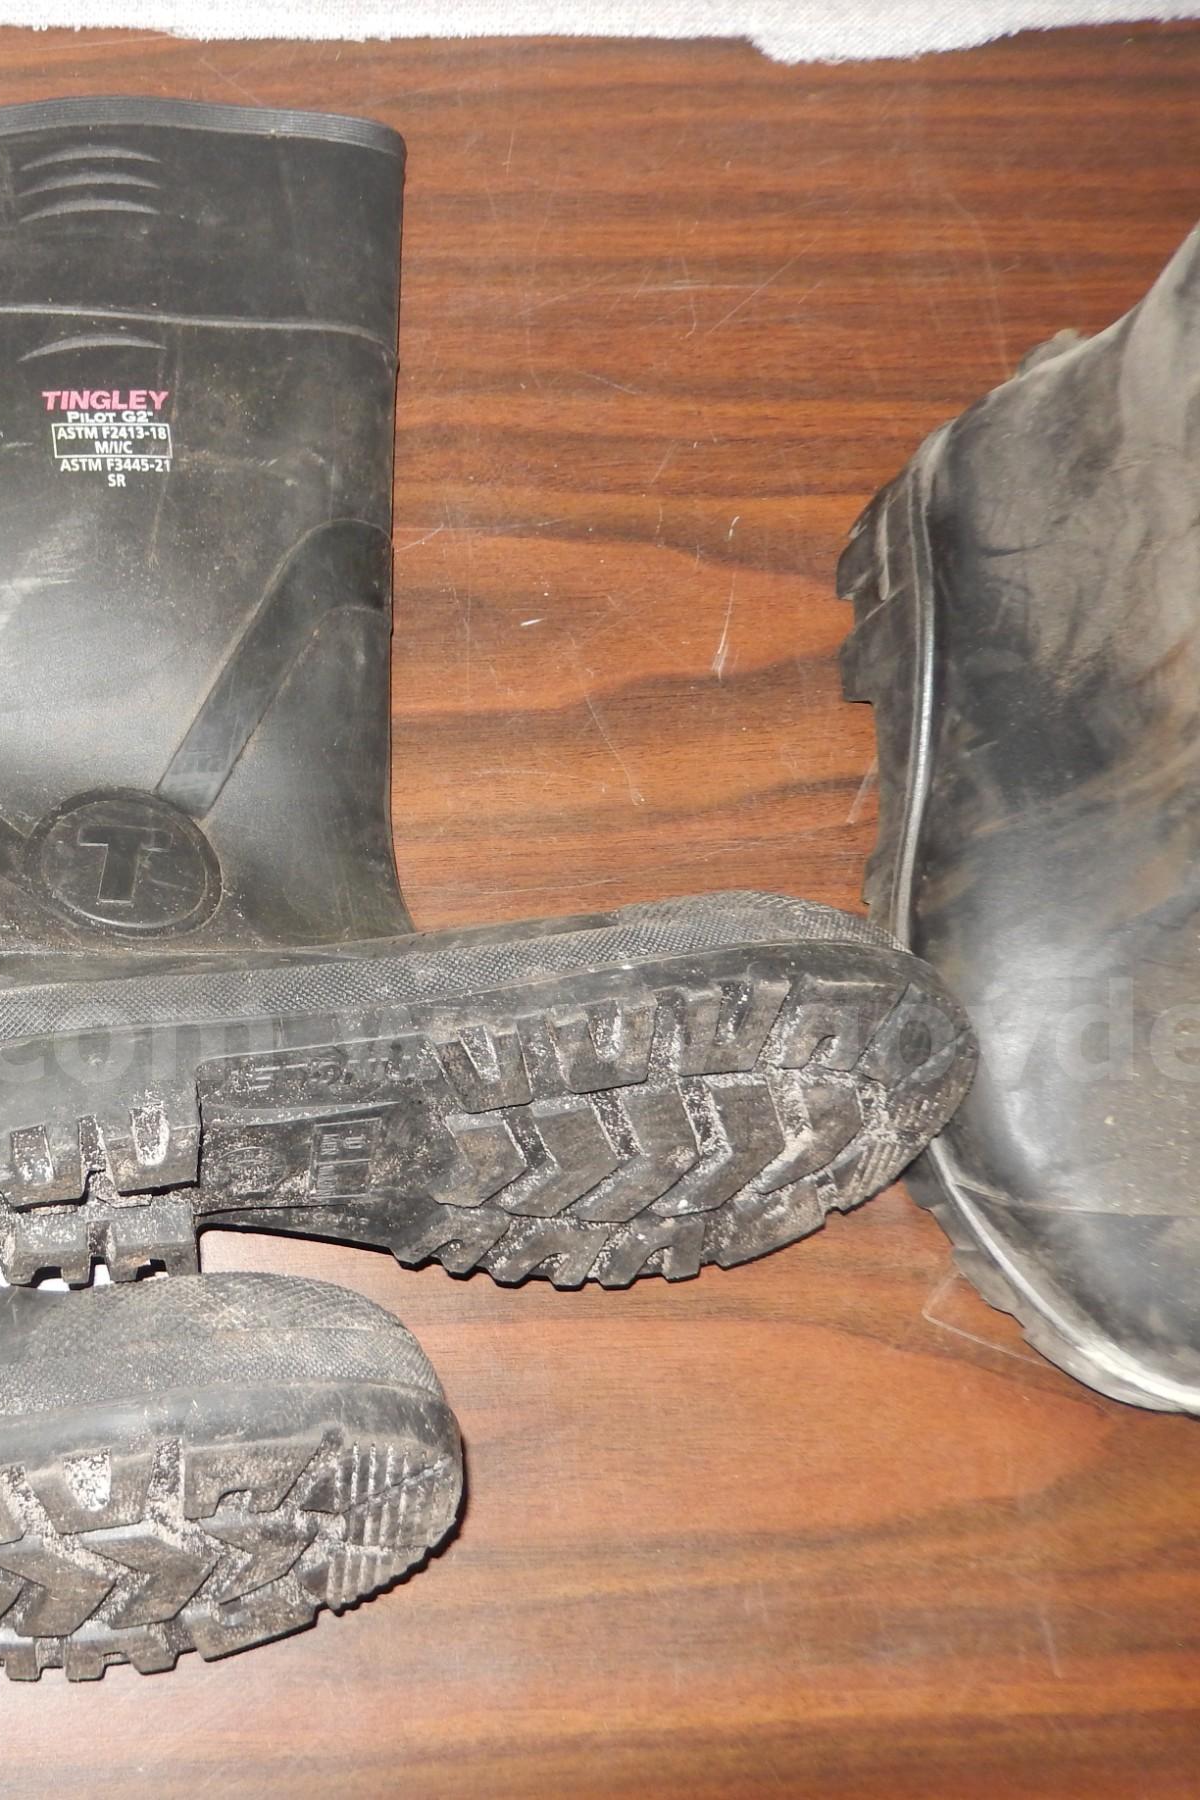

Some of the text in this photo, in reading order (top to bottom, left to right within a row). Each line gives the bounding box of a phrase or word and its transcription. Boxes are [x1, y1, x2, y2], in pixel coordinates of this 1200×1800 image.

[42, 390, 169, 411] TINGLEY
[66, 411, 116, 423] PILOT
[57, 427, 167, 440] ASTM F2413-18
[94, 441, 133, 454] M/I/C
[60, 459, 171, 472] ASTM F3445-21
[107, 475, 127, 488] SR
